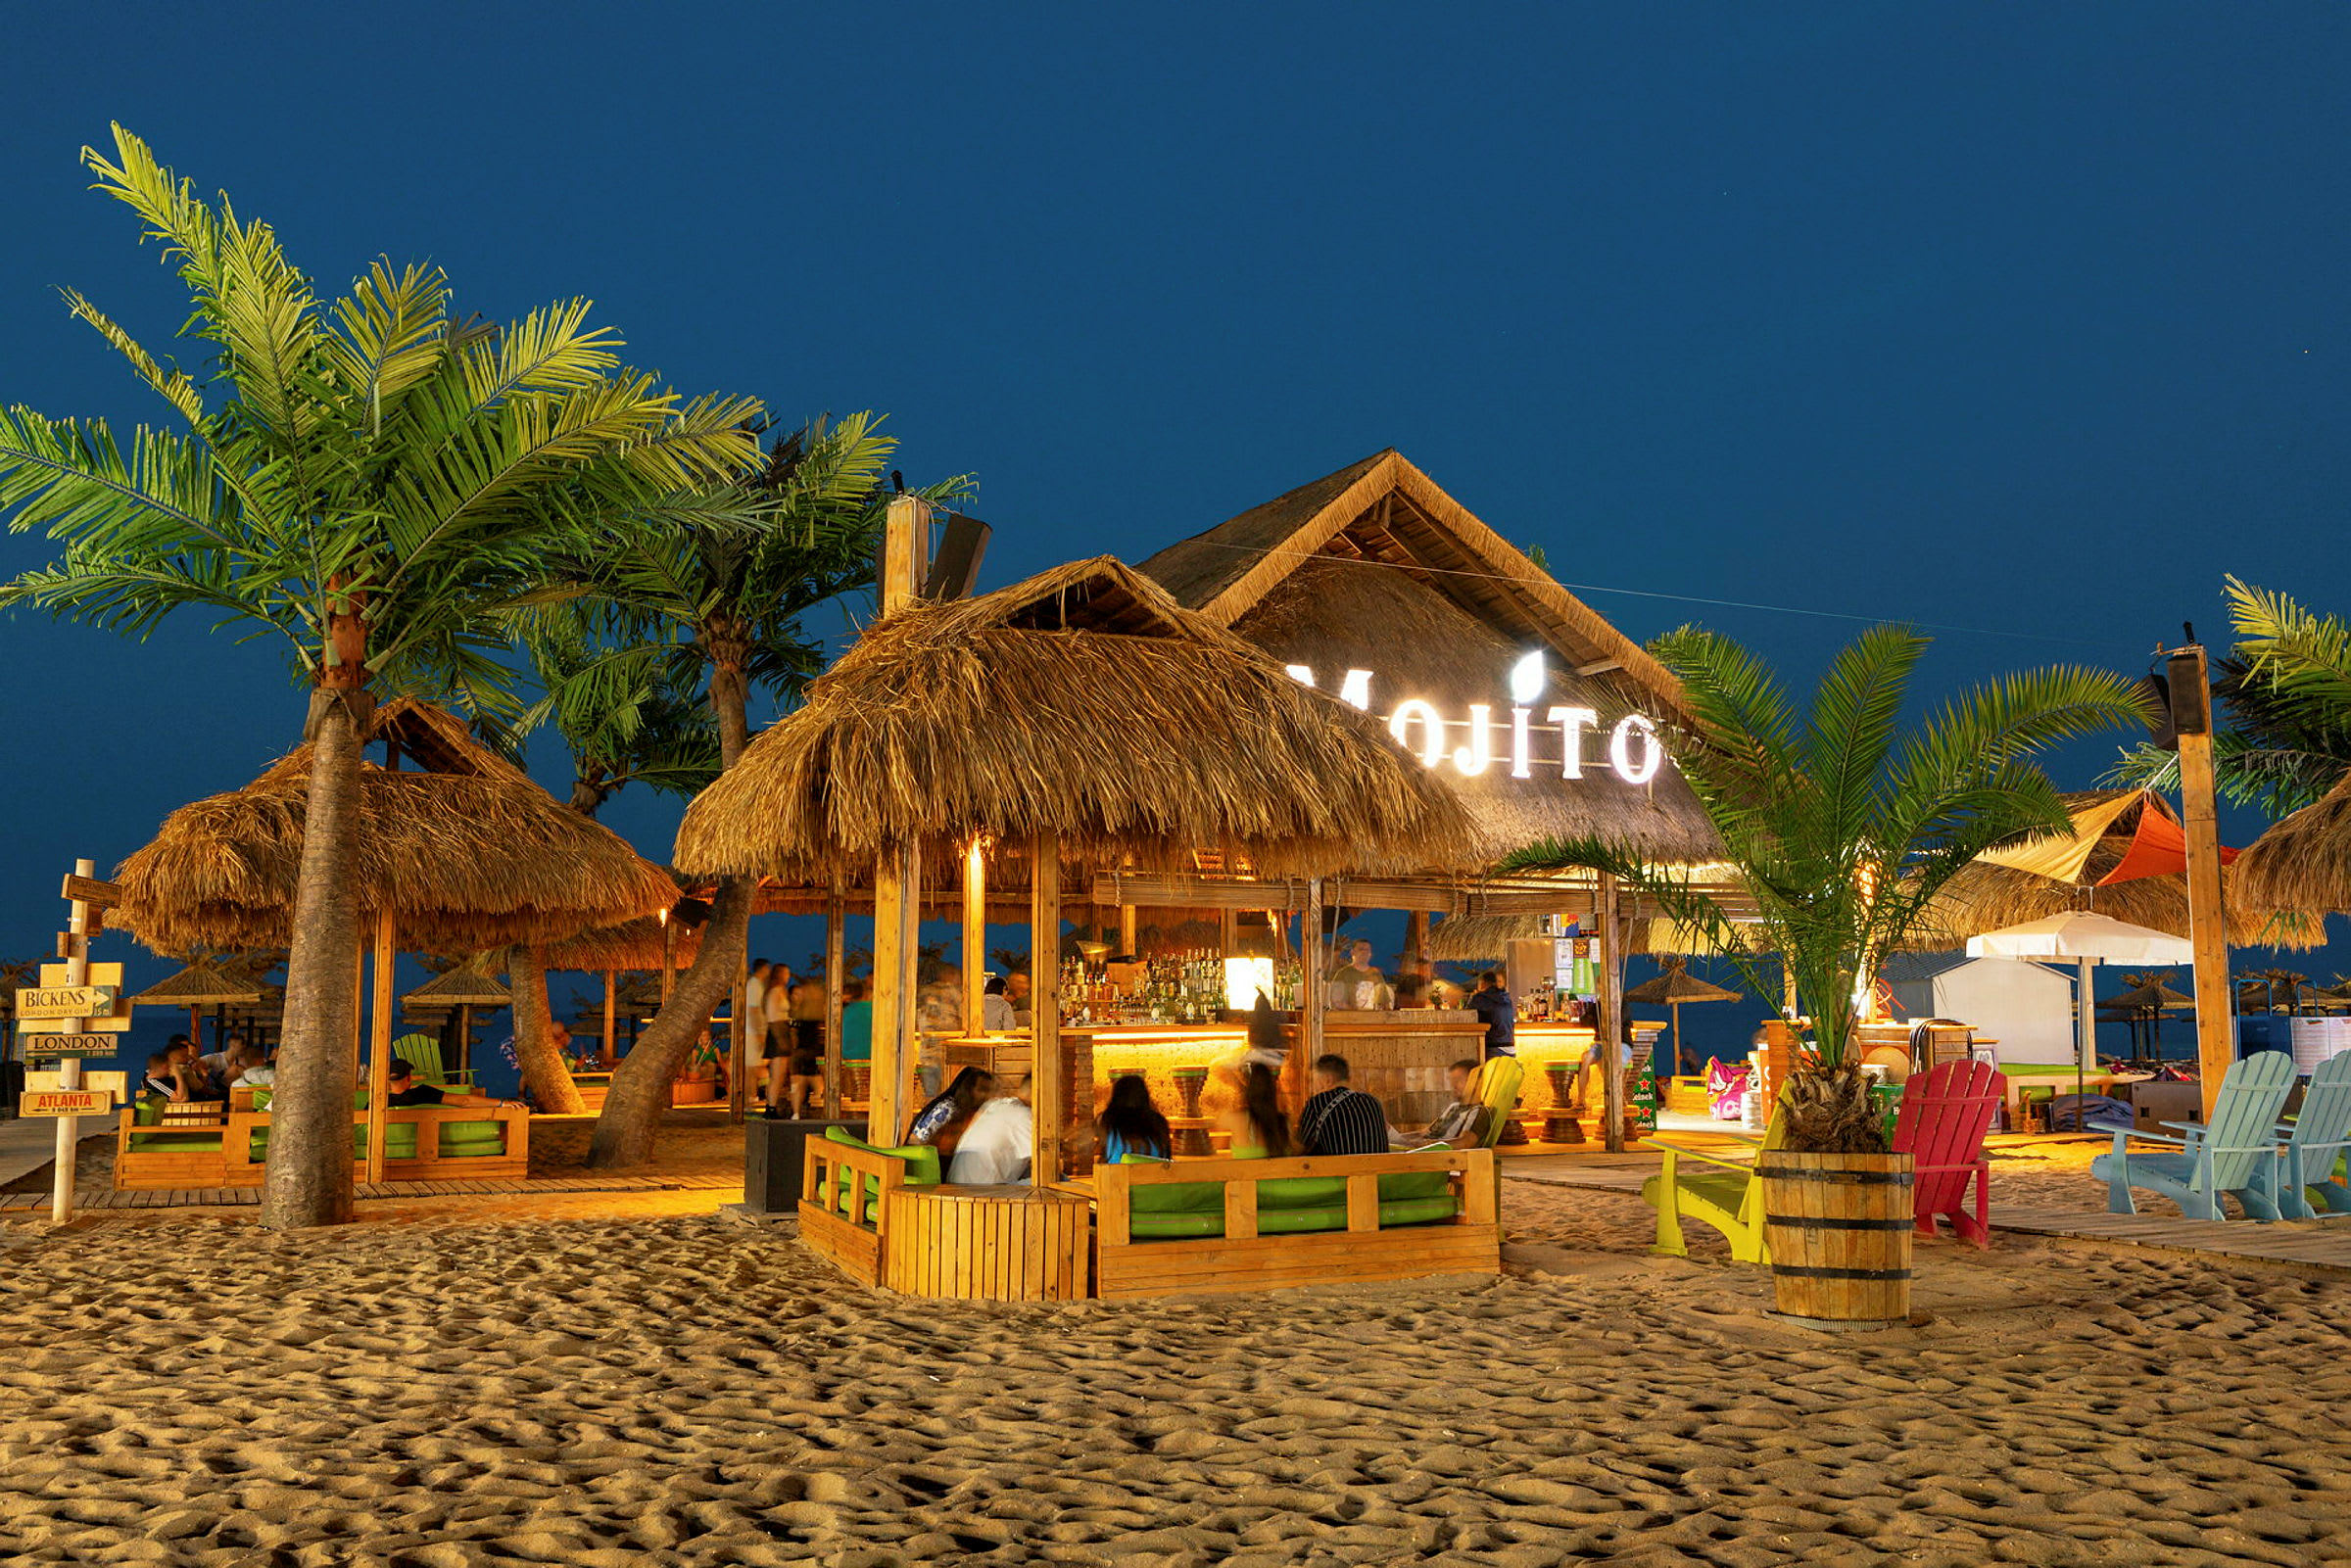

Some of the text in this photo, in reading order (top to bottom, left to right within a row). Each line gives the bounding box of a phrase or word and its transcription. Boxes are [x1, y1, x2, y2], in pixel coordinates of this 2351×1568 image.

[25, 990, 85, 1008] BICKENS
[34, 1036, 110, 1050] LONDON
[38, 1094, 92, 1107] ATLANTA
